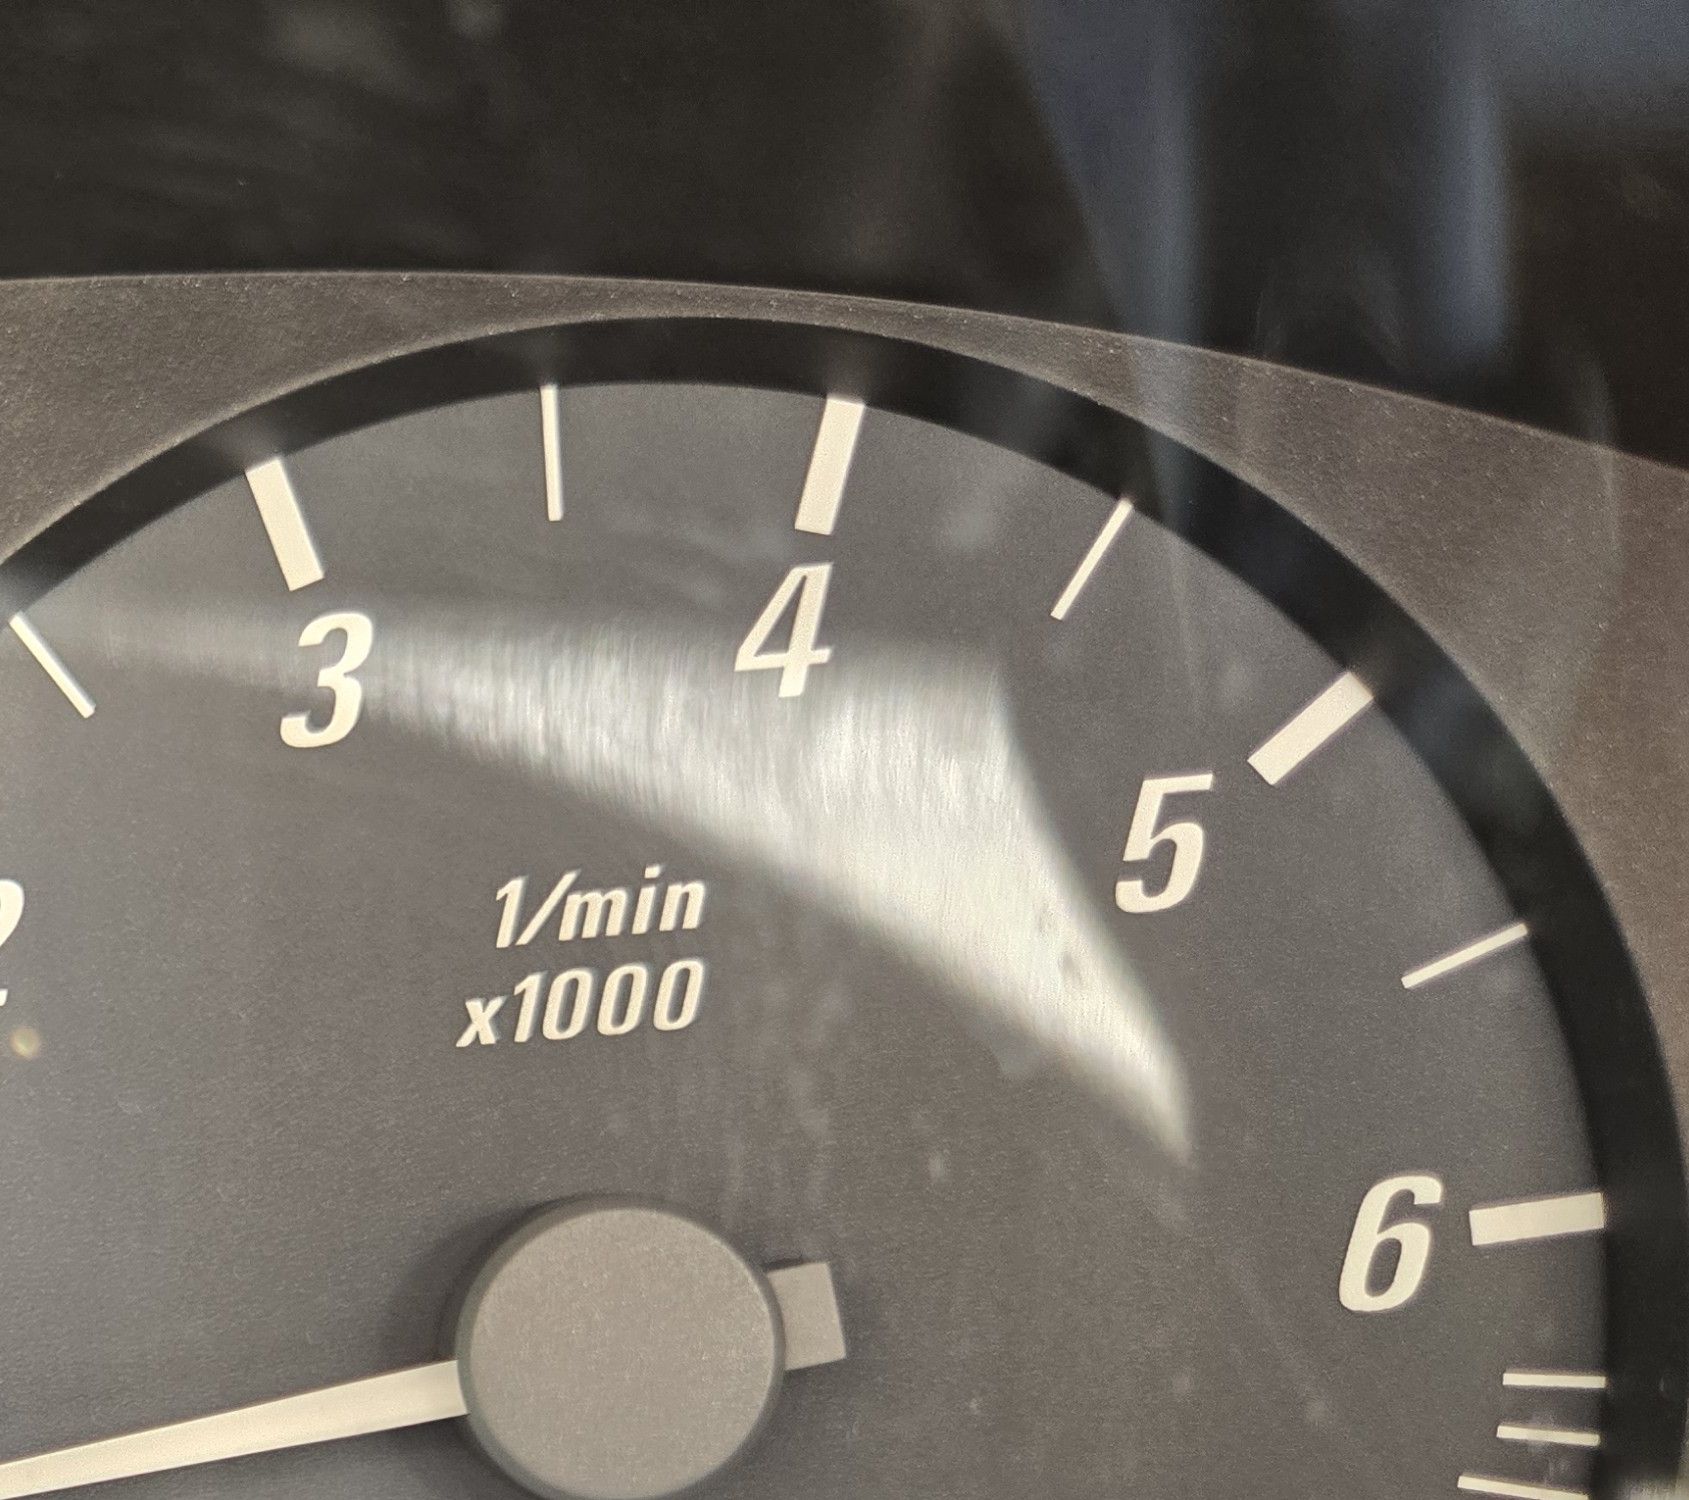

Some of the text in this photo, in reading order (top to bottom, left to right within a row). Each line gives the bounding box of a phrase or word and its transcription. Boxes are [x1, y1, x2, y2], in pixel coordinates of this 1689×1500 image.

[280, 611, 374, 748] 3
[734, 561, 835, 698] 4
[496, 864, 706, 948] 1/min
[1115, 772, 1214, 913] 5
[456, 958, 705, 1047] x1000
[1339, 1174, 1444, 1313] 6
